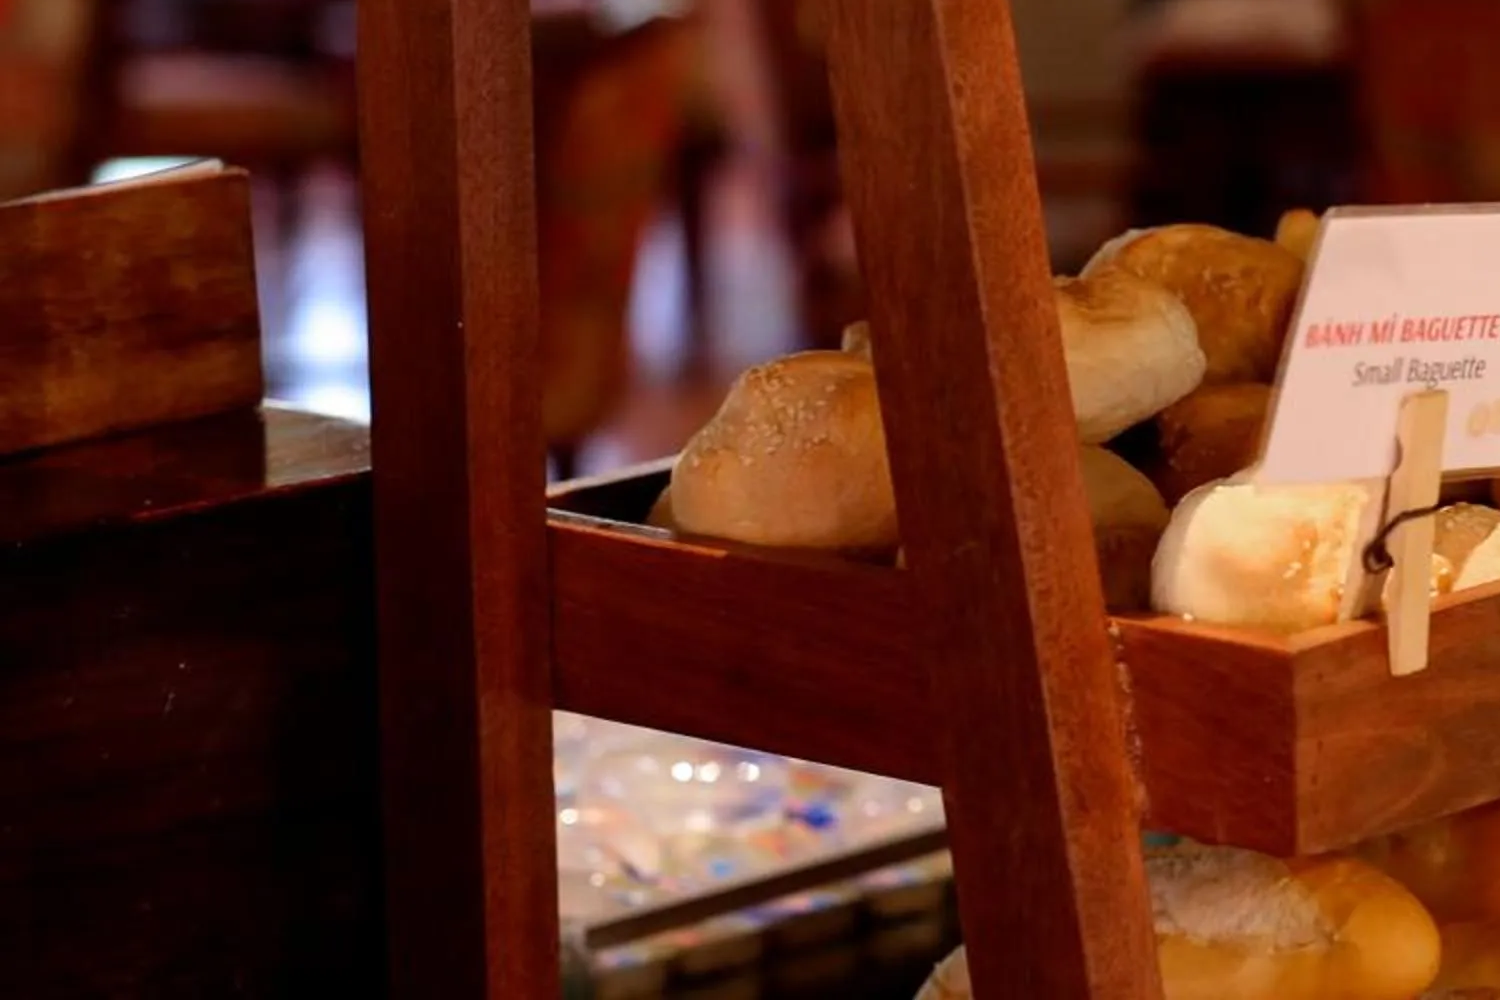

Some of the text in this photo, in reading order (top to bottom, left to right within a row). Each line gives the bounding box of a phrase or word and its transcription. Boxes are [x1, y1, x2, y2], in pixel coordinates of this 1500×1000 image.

[1305, 316, 1364, 349] BÁNH
[1352, 356, 1487, 391] Small Baguette
